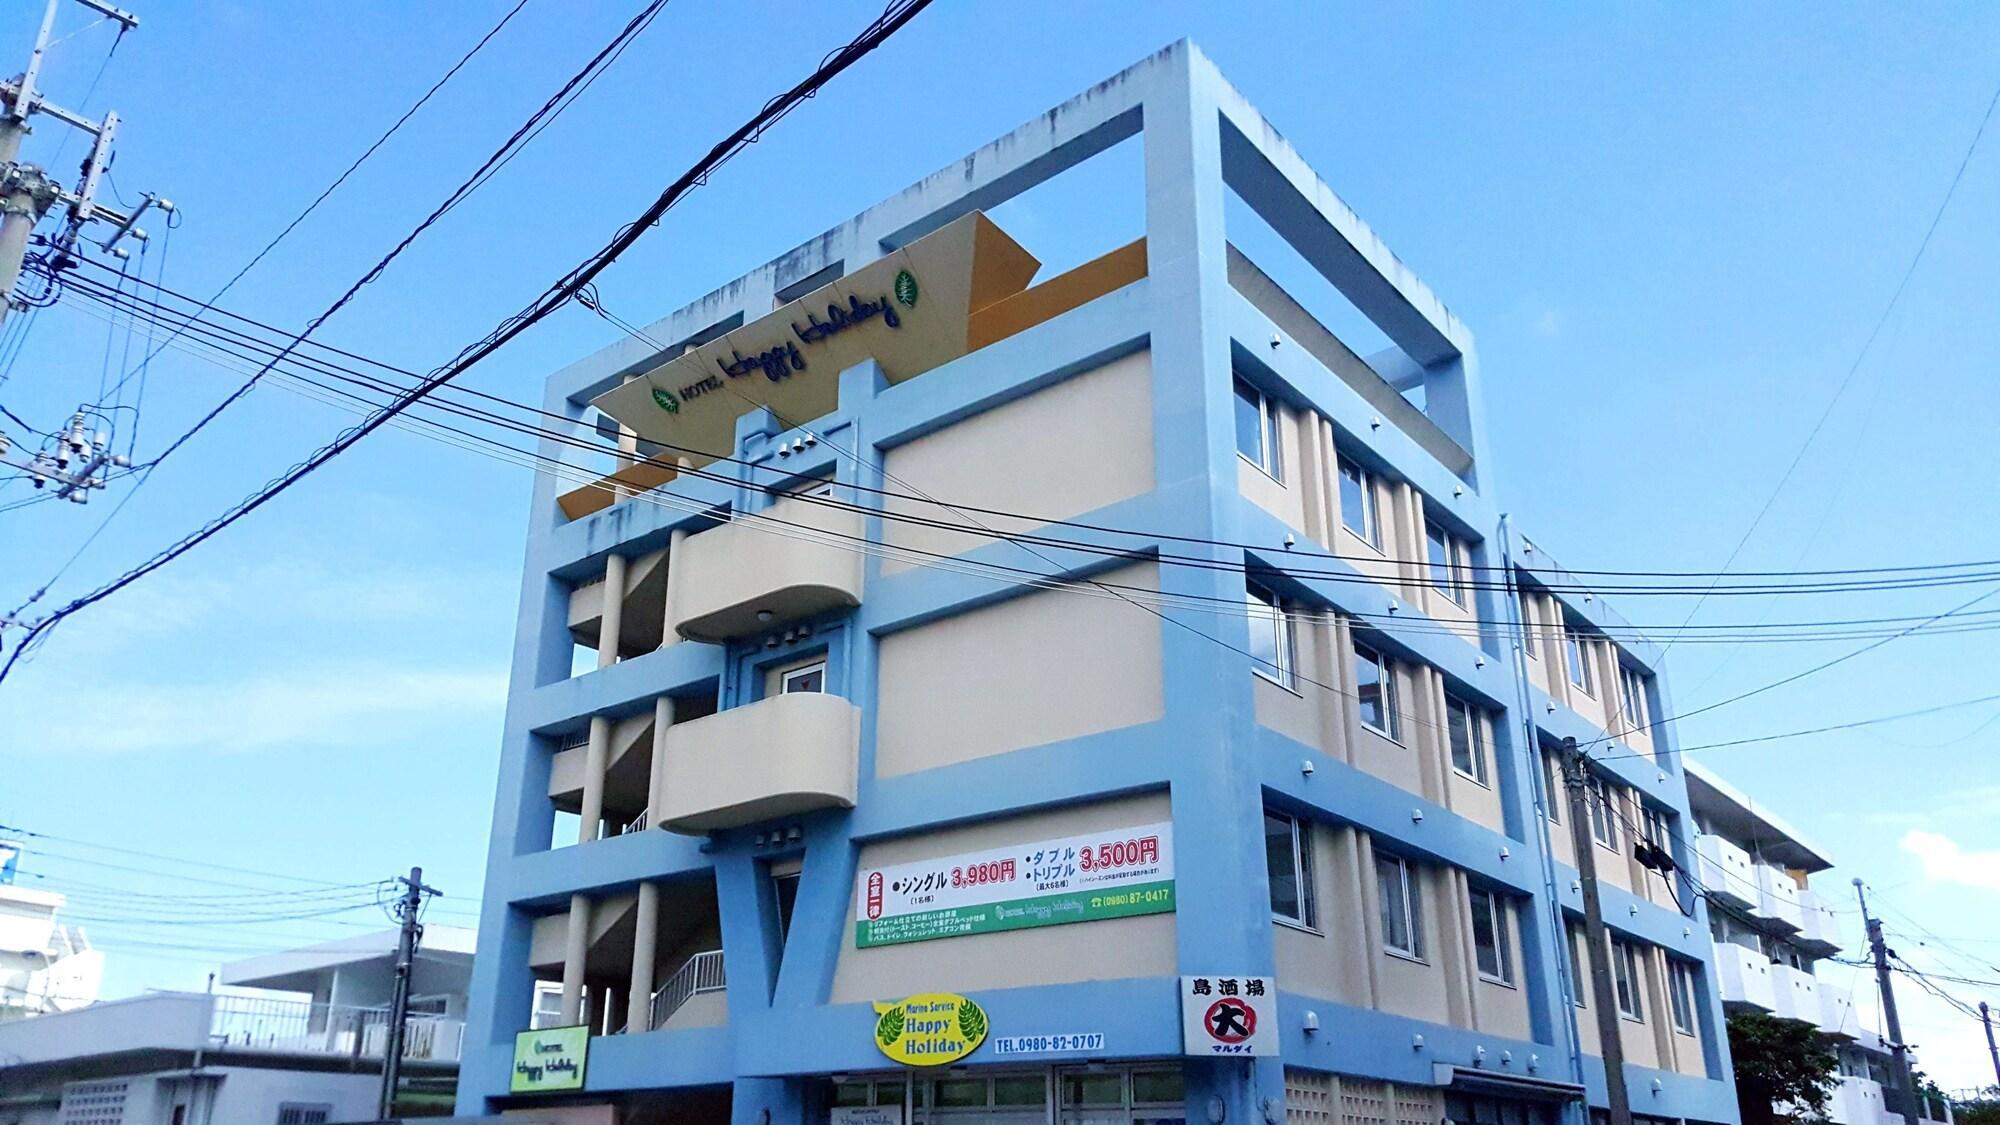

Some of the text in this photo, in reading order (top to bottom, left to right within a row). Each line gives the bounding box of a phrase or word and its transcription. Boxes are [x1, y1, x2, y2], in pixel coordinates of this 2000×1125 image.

[1080, 836, 1158, 872] 3,500円
[951, 858, 1017, 888] 3,980円
[1192, 978, 1265, 996] 島酒場
[906, 1001, 955, 1013] Marine Service
[906, 1018, 951, 1034] Happy
[906, 1038, 965, 1055] Holiday
[1211, 1045, 1253, 1054] マルダイ
